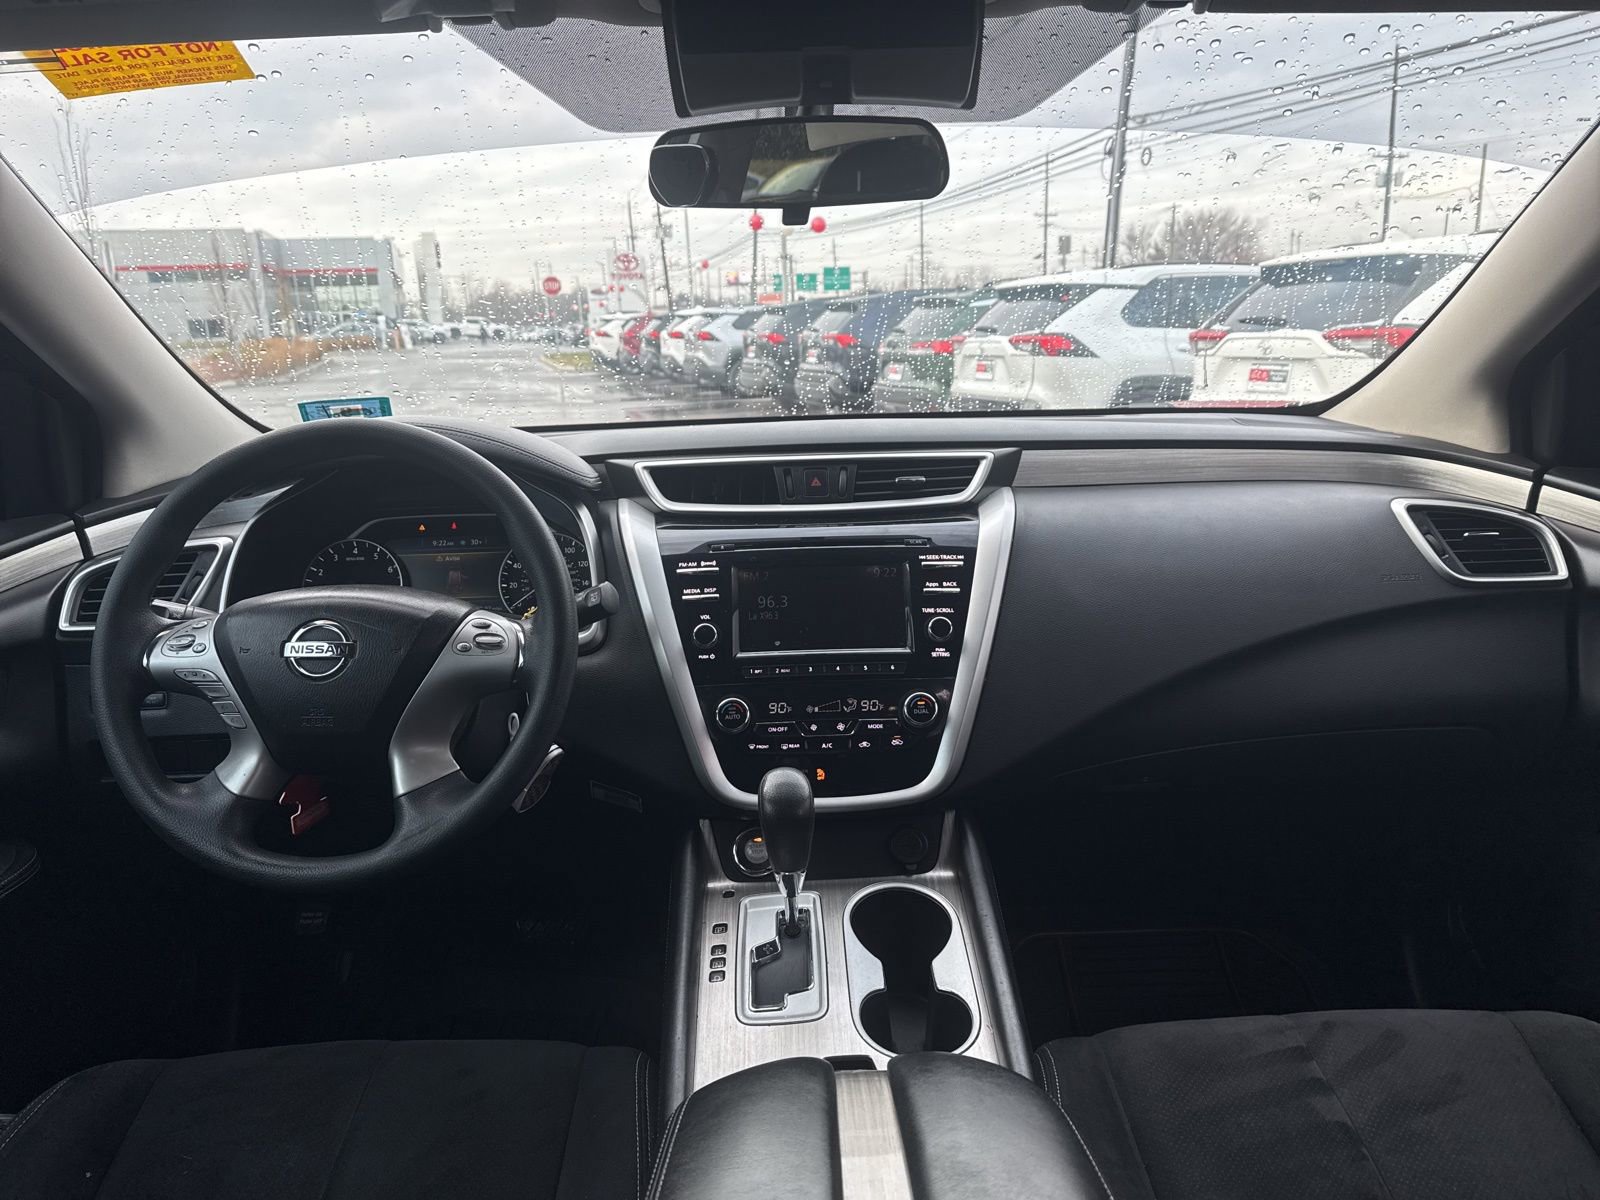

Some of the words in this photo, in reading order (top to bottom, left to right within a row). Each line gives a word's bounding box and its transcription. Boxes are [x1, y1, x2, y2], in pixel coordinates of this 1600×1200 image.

[611, 272, 645, 280] TOYOTA
[544, 281, 560, 290] STOP
[333, 554, 339, 562] 3
[373, 552, 379, 560] 5
[577, 560, 589, 568] 120
[318, 568, 324, 576] 2
[387, 565, 393, 574] 6
[873, 567, 897, 578] 9:22
[757, 595, 788, 609] 96.3
[289, 644, 350, 655] NISSAN
